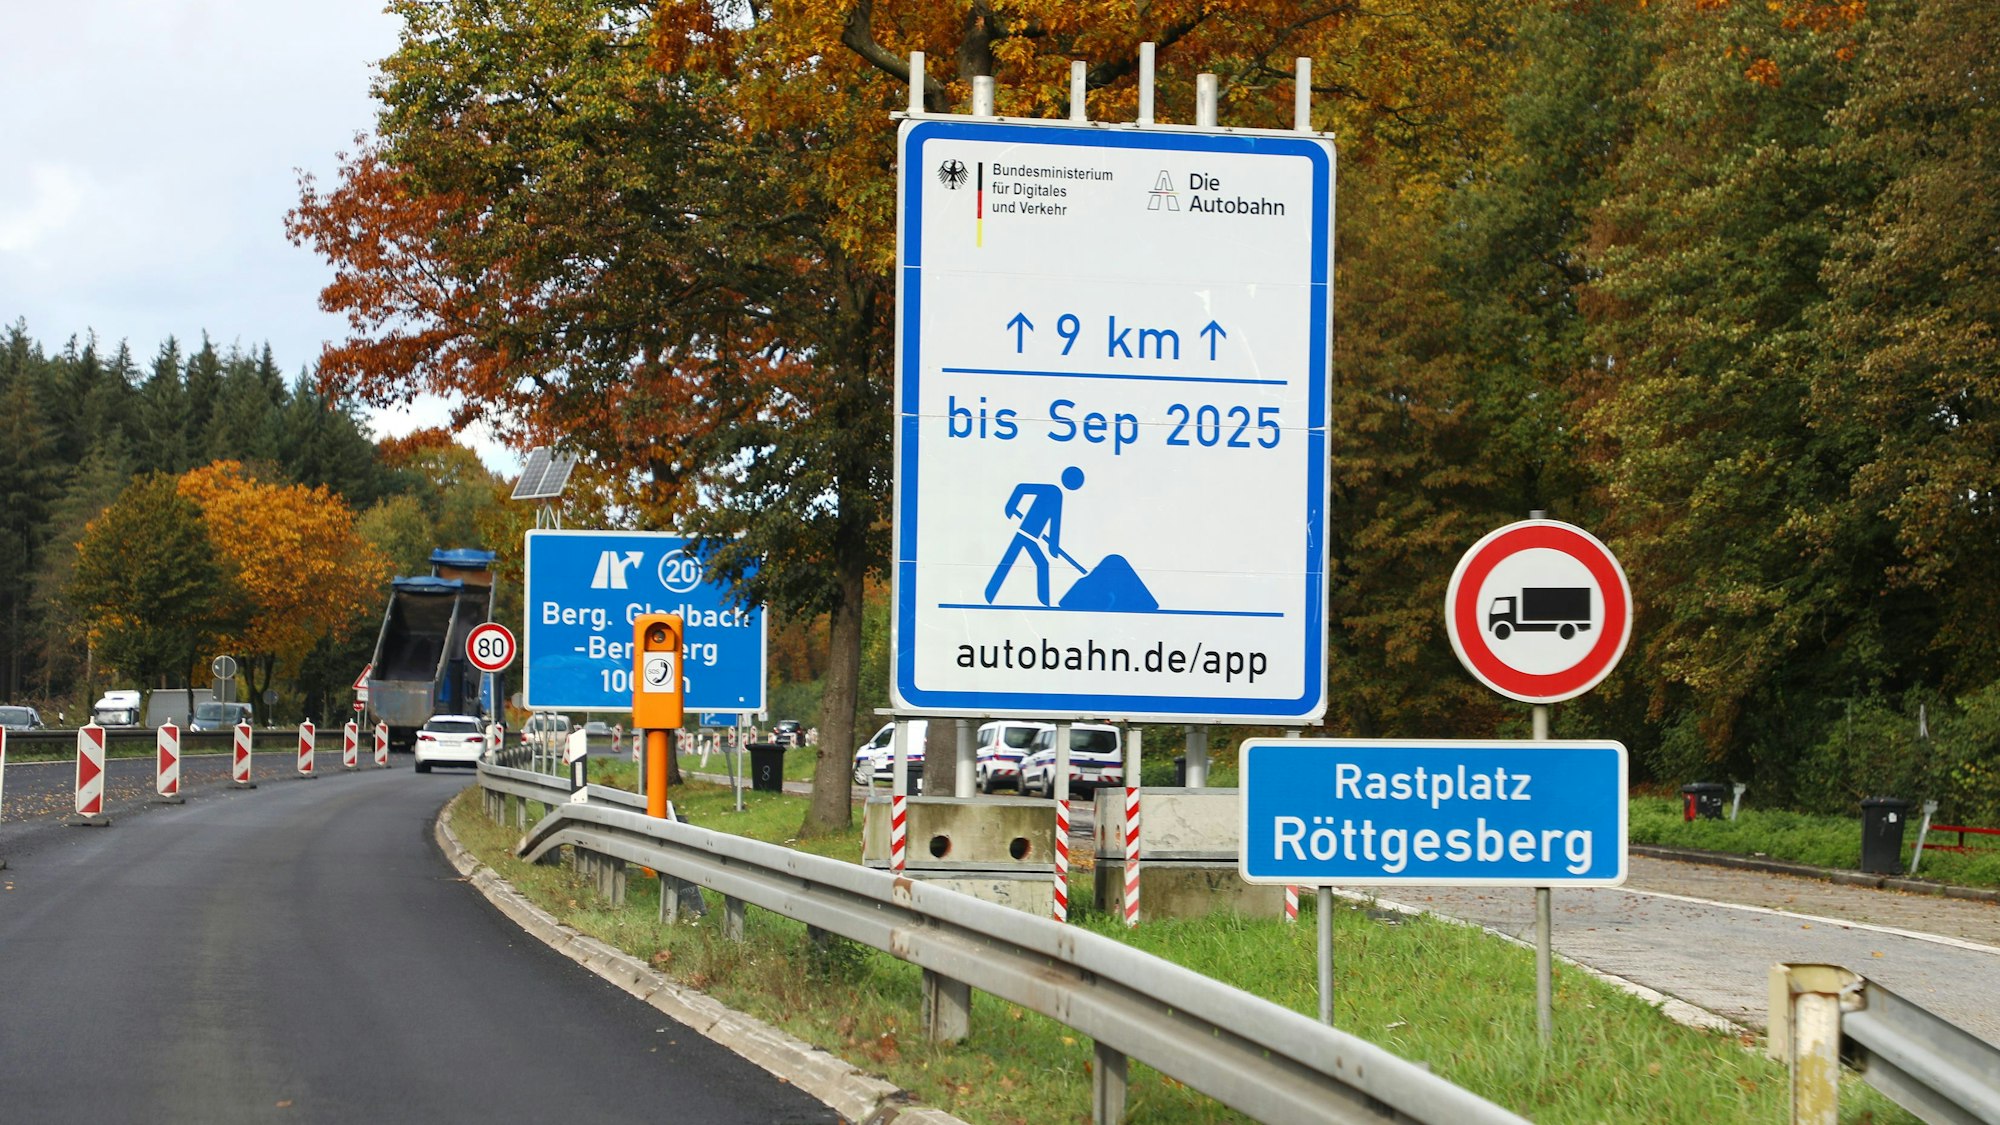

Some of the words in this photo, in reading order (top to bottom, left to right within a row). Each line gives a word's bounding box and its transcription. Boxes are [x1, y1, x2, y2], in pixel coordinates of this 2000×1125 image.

[992, 162, 1113, 181] Bundesministerium
[1189, 172, 1220, 191] Die
[992, 181, 1010, 195] für
[1013, 182, 1067, 199] Digitales
[992, 201, 1016, 215] und
[1019, 201, 1068, 217] Verkehr
[1188, 195, 1285, 216] Autobahn
[1056, 313, 1081, 356] 9
[1108, 315, 1180, 360] km
[948, 395, 1019, 441] bis
[1047, 399, 1139, 456] Sep
[1166, 403, 1281, 449] 2025
[665, 559, 696, 584] 20
[542, 601, 613, 632] Berg.
[477, 637, 505, 659] 80
[956, 638, 1268, 684] autobahn.de/app
[1335, 763, 1532, 810] Rastplatz
[1273, 815, 1594, 875] Röttgesberg
